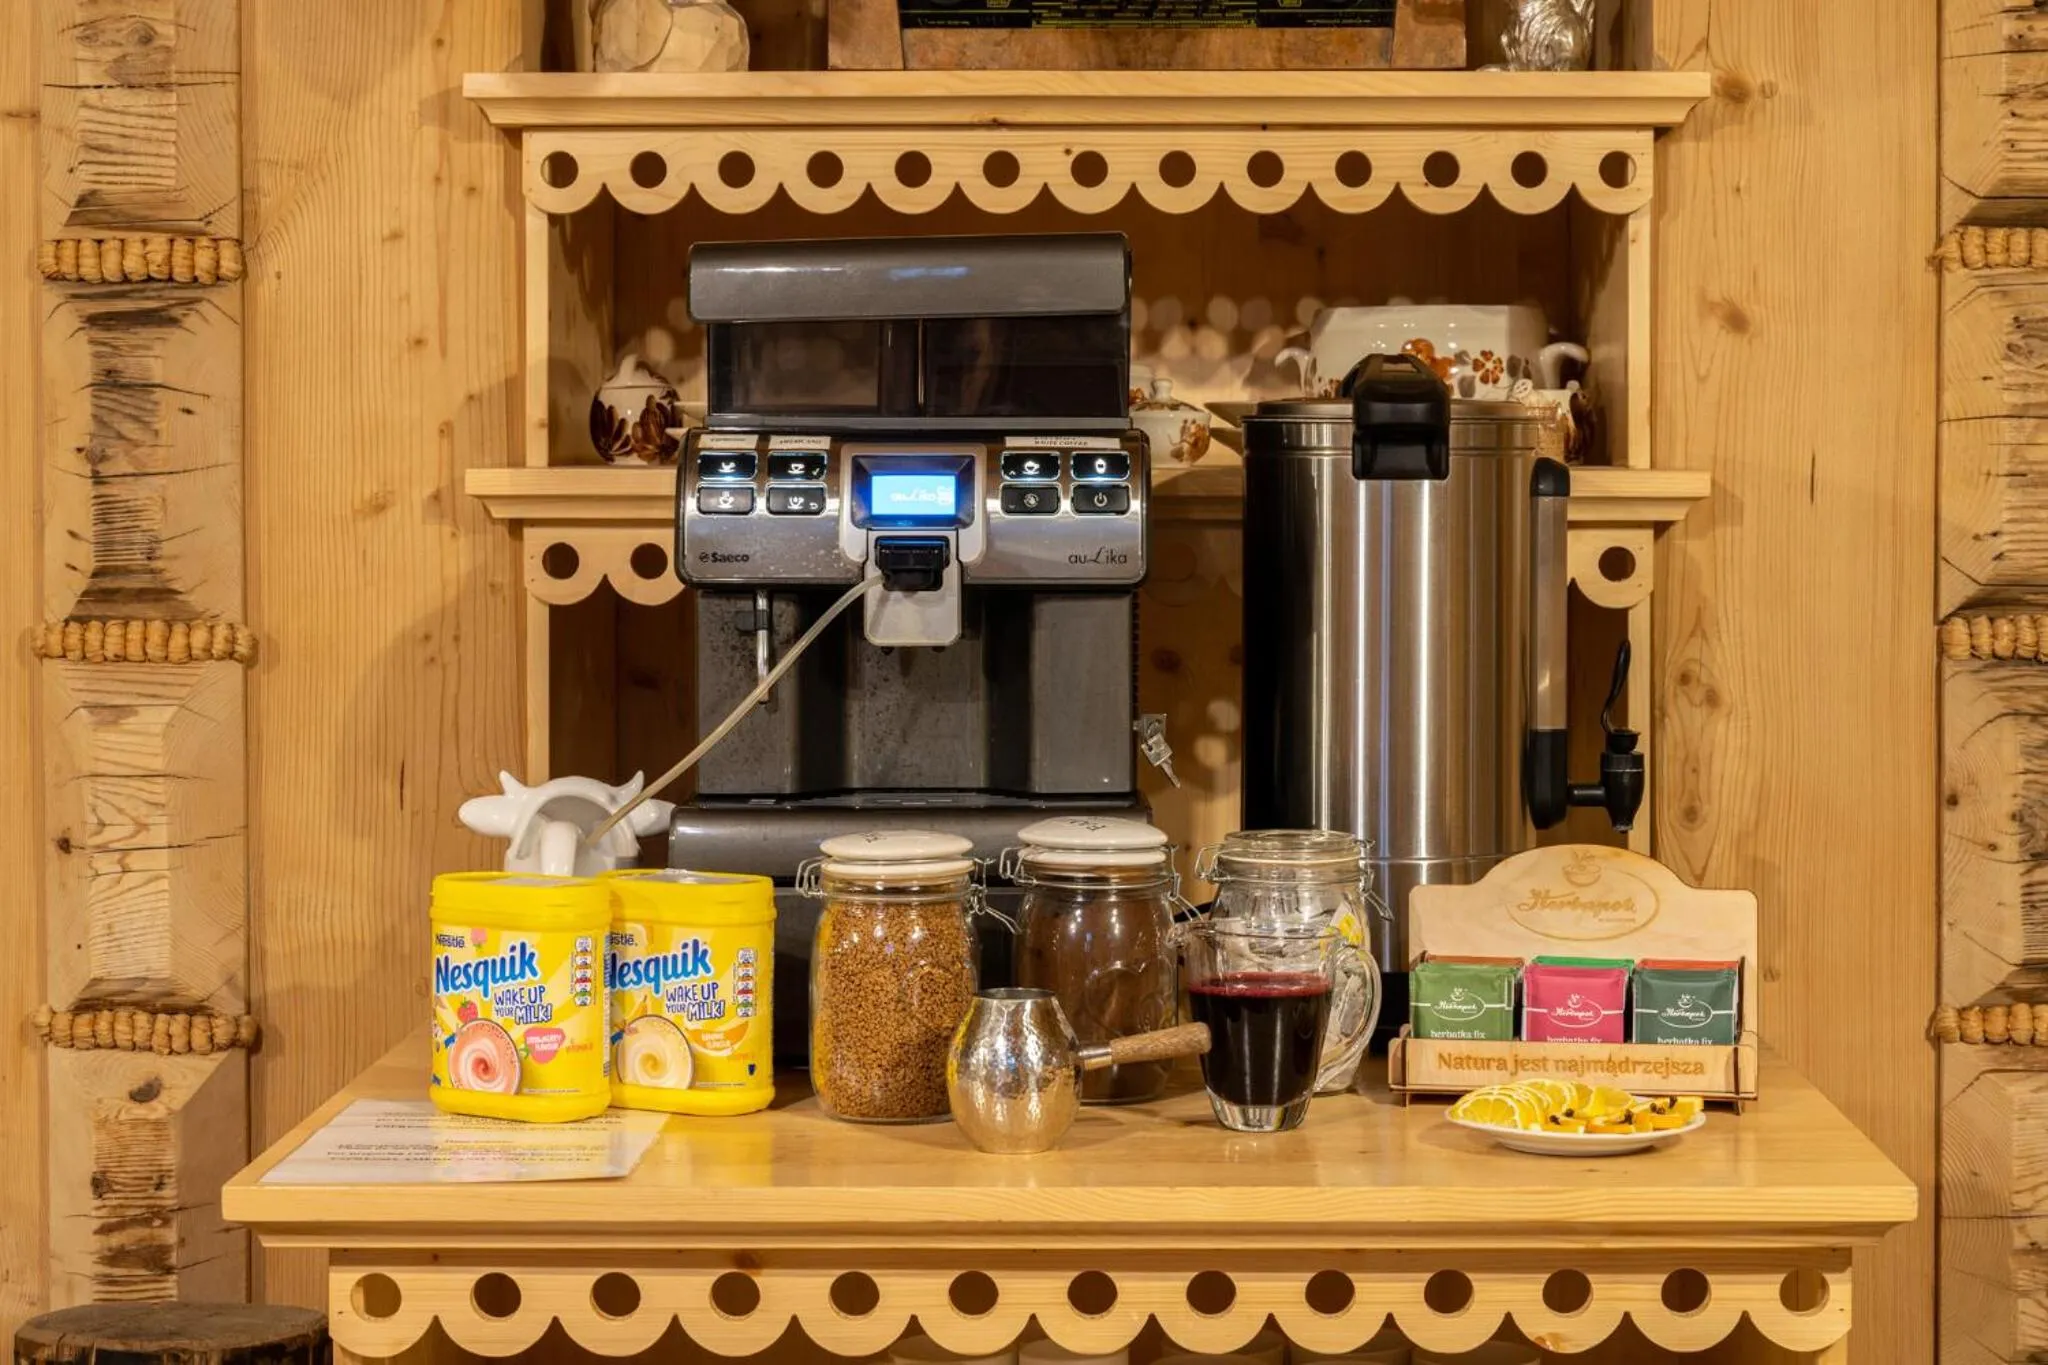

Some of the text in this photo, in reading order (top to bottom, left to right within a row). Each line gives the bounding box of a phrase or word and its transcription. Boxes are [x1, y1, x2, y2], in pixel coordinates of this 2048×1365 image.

[711, 551, 750, 563] Saeco
[436, 941, 539, 998] Nesquik
[494, 984, 546, 1006] WAKE UP
[666, 982, 719, 1003] WAKE UP
[494, 1003, 553, 1025] YOUR MILK!
[666, 1000, 726, 1022] YOUR MILK!
[1430, 1029, 1487, 1039] herbatka fix
[1437, 1052, 1706, 1079] Natura jest najmądrzejsza
